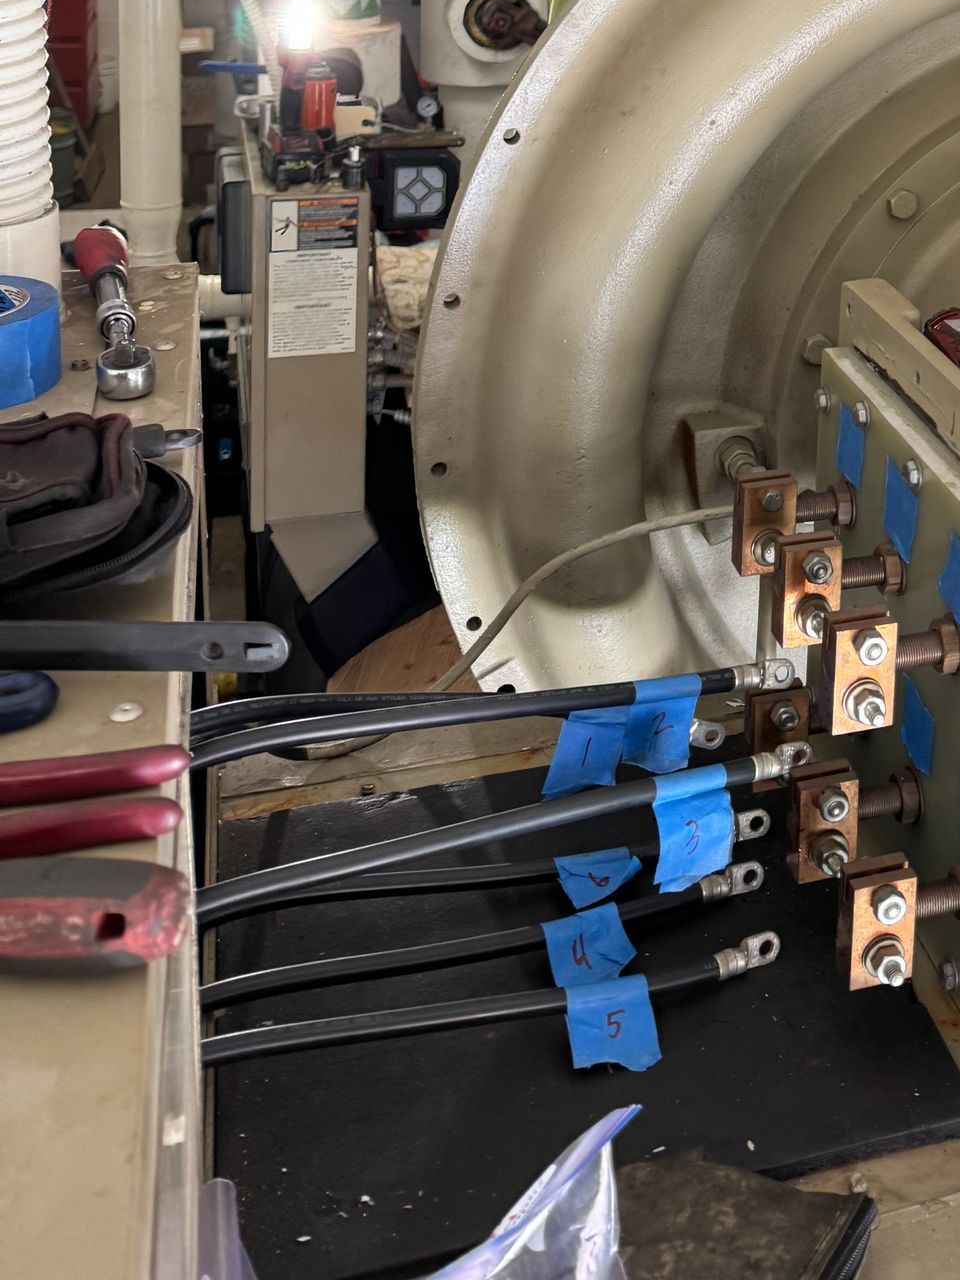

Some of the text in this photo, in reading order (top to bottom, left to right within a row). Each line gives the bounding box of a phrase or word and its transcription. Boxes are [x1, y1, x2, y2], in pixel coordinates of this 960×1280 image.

[650, 711, 674, 736] 2
[581, 736, 593, 768] 1
[684, 819, 701, 856] 3
[571, 932, 593, 972] 4
[606, 1008, 626, 1039] 5
